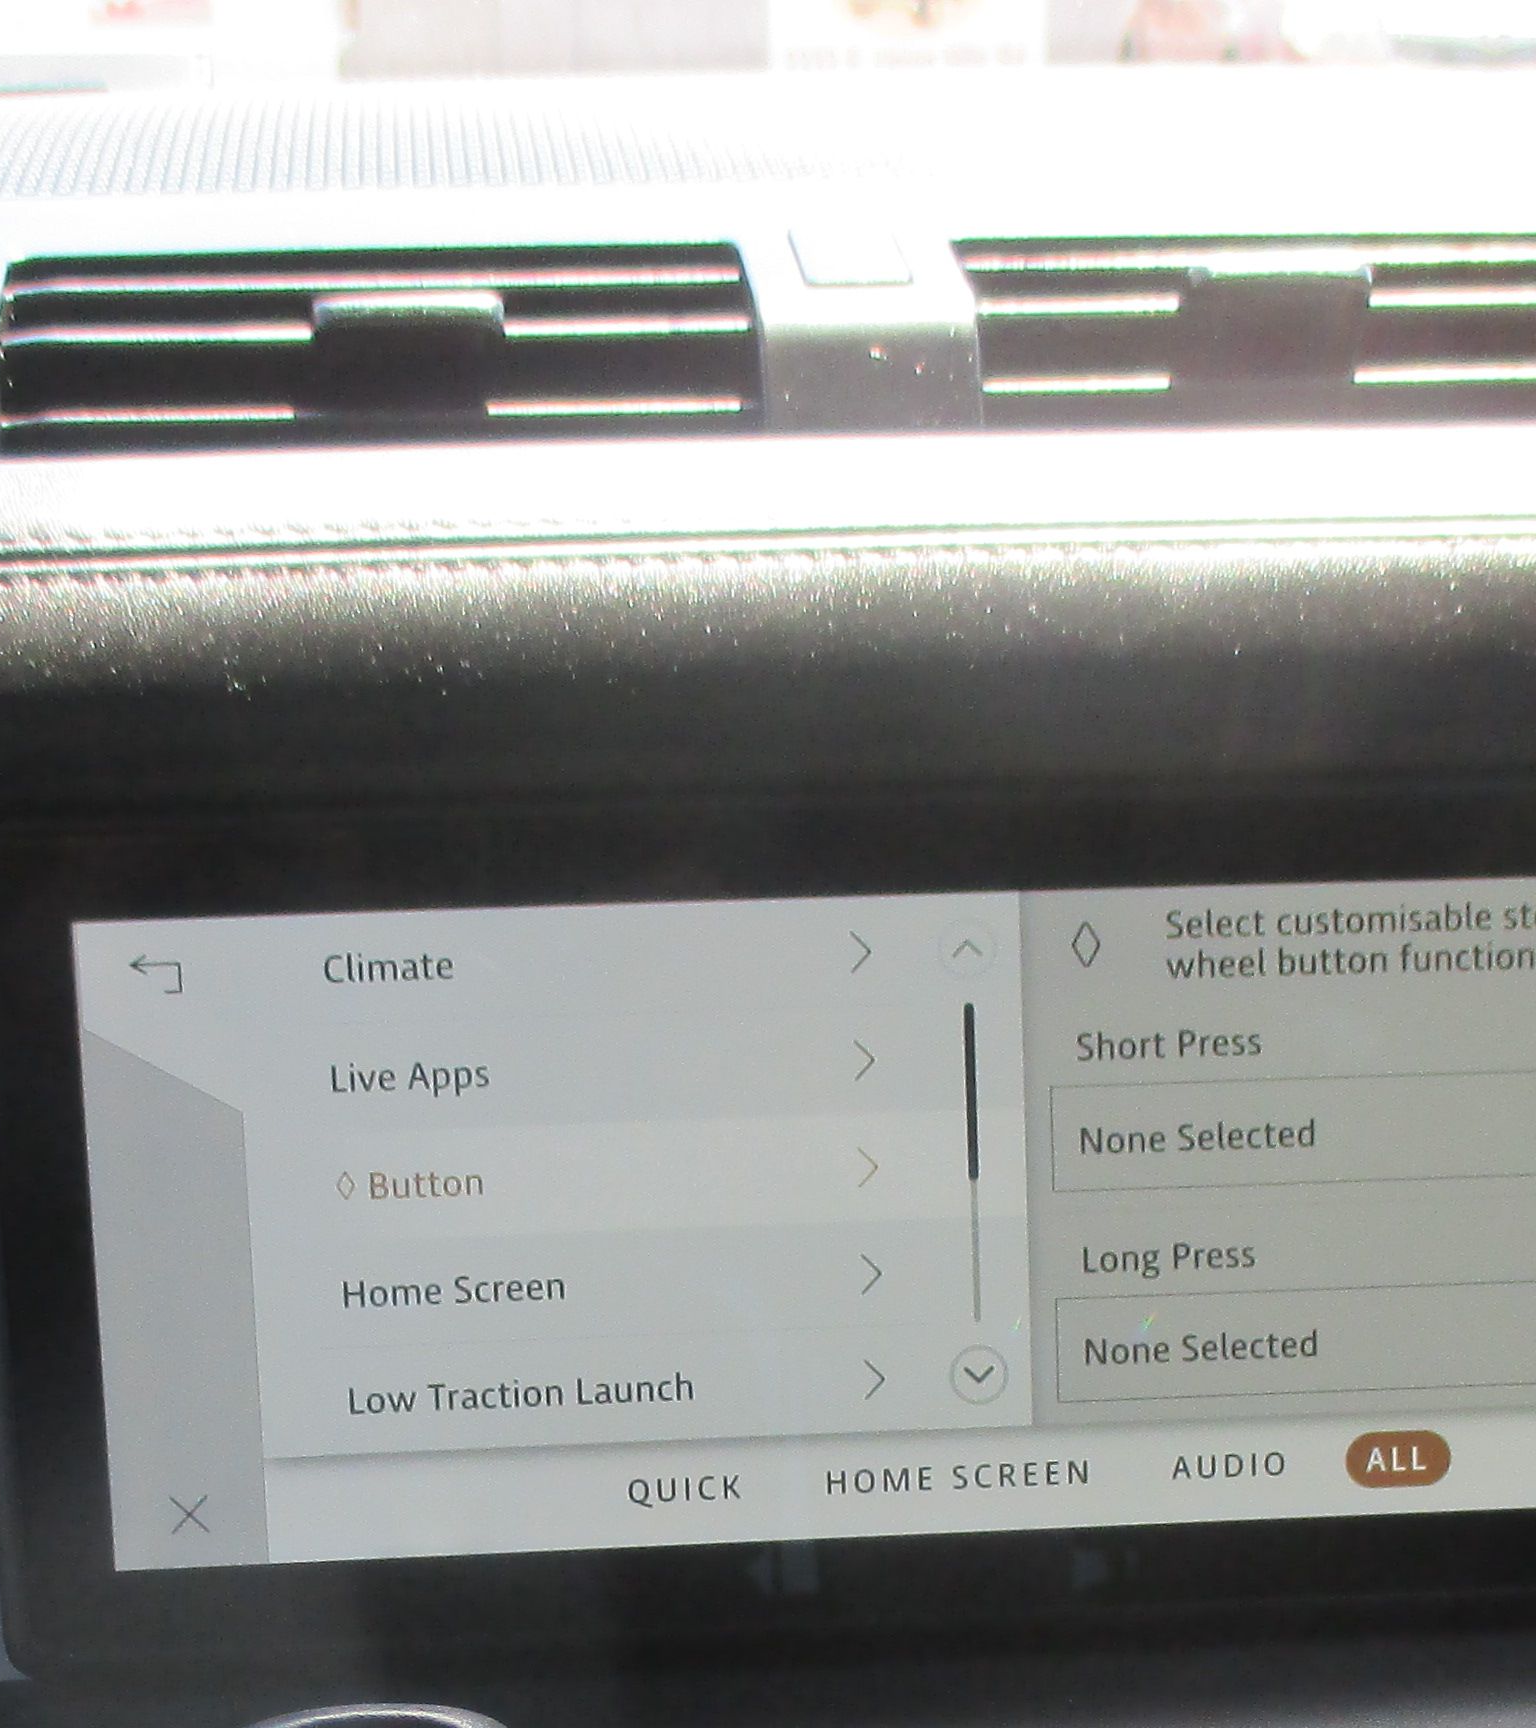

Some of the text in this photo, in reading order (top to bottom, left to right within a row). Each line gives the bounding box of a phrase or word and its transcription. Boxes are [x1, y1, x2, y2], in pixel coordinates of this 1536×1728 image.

[1164, 908, 1266, 939] Select
[1276, 904, 1492, 937] customisable
[323, 950, 455, 985] Climate
[1166, 942, 1536, 980] wheel button function
[1075, 1027, 1263, 1063] Short Press
[329, 1060, 492, 1097] Live Apps
[1079, 1118, 1316, 1155] None Selected
[368, 1168, 484, 1201] Button
[1081, 1240, 1256, 1278] Long Press
[342, 1271, 567, 1309] Home Screen
[1083, 1330, 1320, 1367] None Selected
[347, 1371, 695, 1416] Low Traction Launch
[825, 1458, 1091, 1497] HOME SCREEN
[1171, 1451, 1287, 1482] AUDIO
[1364, 1445, 1428, 1475] ALL
[627, 1473, 743, 1509] QUICK
